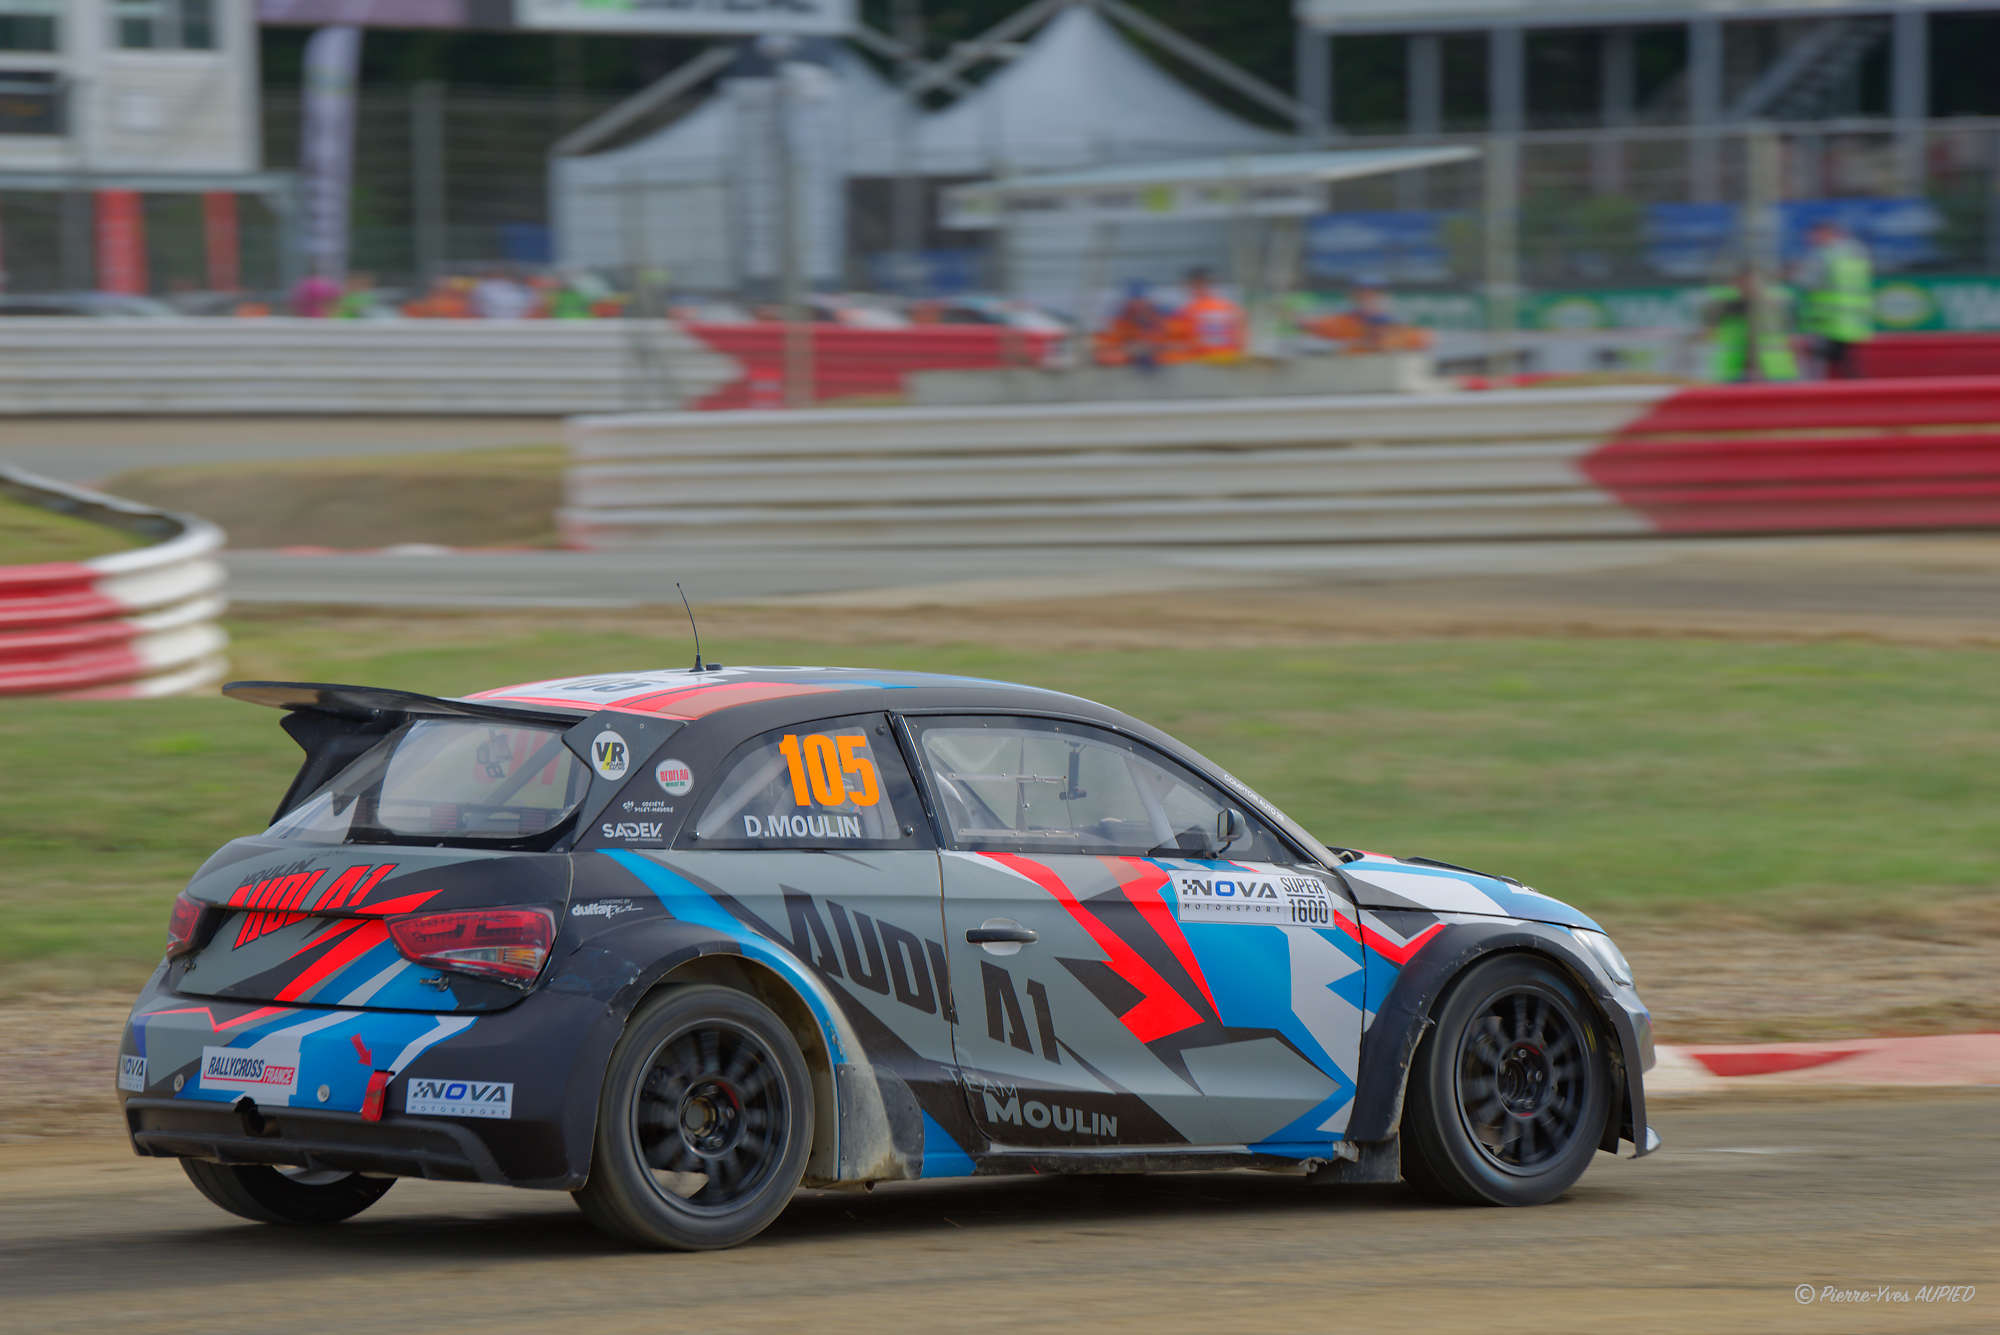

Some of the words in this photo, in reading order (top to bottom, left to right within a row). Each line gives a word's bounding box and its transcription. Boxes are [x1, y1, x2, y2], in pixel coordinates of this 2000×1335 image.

[778, 734, 880, 807] 105
[743, 815, 862, 838] D.MOULIN
[311, 863, 401, 914] A1
[1182, 879, 1278, 899] NOVA
[1280, 876, 1324, 895] SUPER
[1183, 903, 1281, 913] MOTORSPORT
[1289, 898, 1329, 924] 1600
[779, 883, 959, 1026] AUDI
[980, 959, 1062, 1066] A1
[207, 1055, 265, 1079] RALLYCROSS
[264, 1067, 293, 1085] FRANCE
[414, 1082, 507, 1103] NOVA
[983, 1093, 1118, 1138] MOULIN
